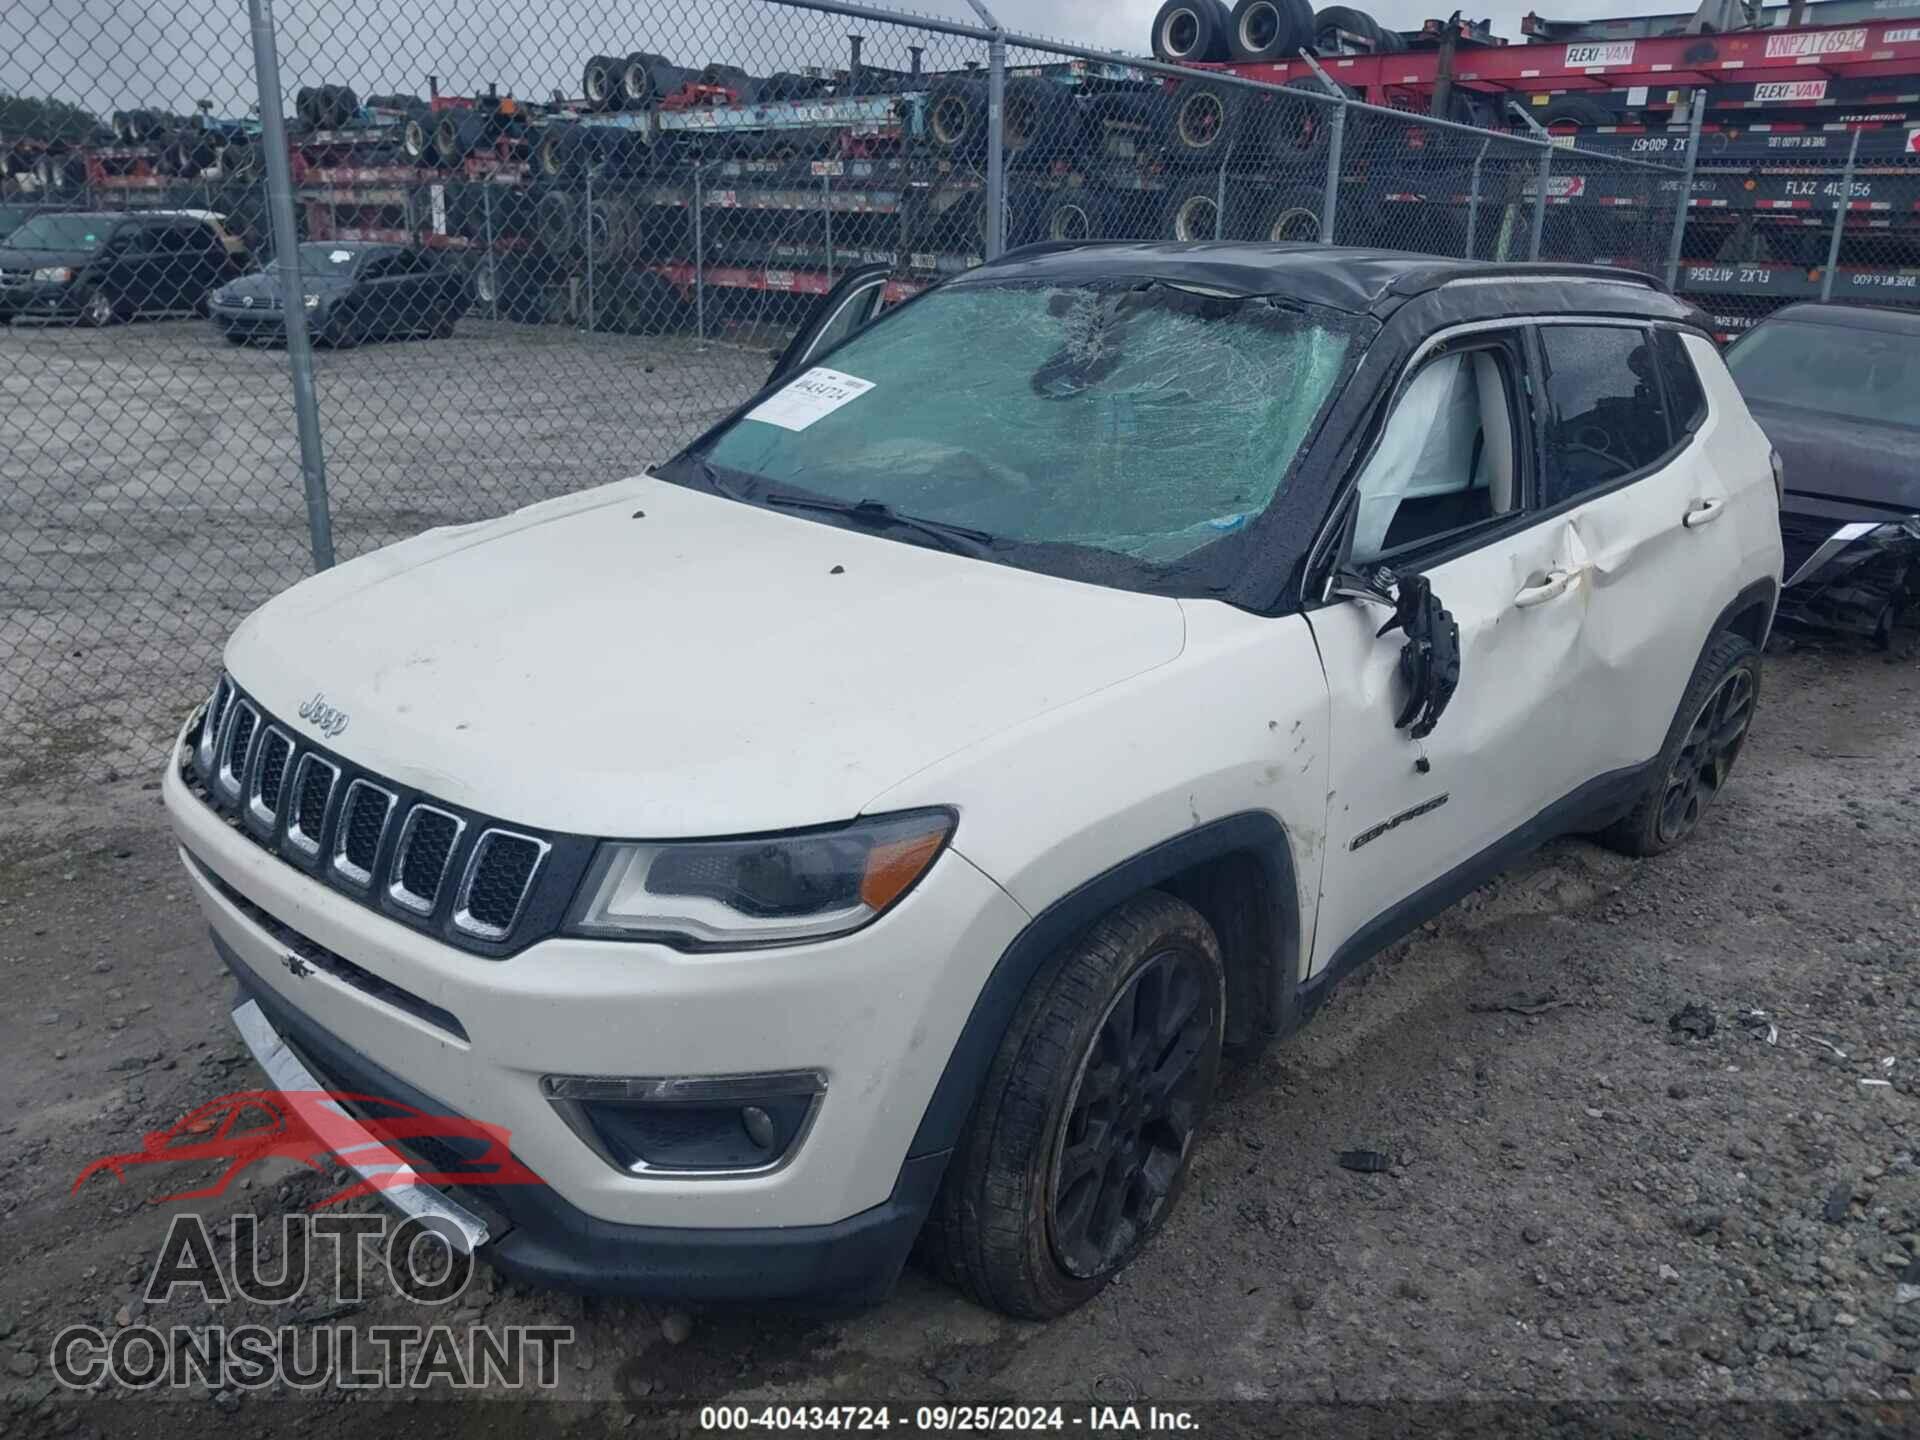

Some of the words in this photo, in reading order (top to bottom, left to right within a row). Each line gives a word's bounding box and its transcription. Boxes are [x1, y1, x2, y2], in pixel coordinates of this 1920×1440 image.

[1567, 46, 1633, 62] FLEXI-VAN
[1757, 81, 1823, 99] FLEXI-VAN
[1631, 138, 1669, 152] 600457
[1785, 181, 1818, 195] FLXZ
[1690, 267, 1735, 282] 417356
[1740, 270, 1771, 283] FLXZ
[299, 692, 350, 739] Jeep
